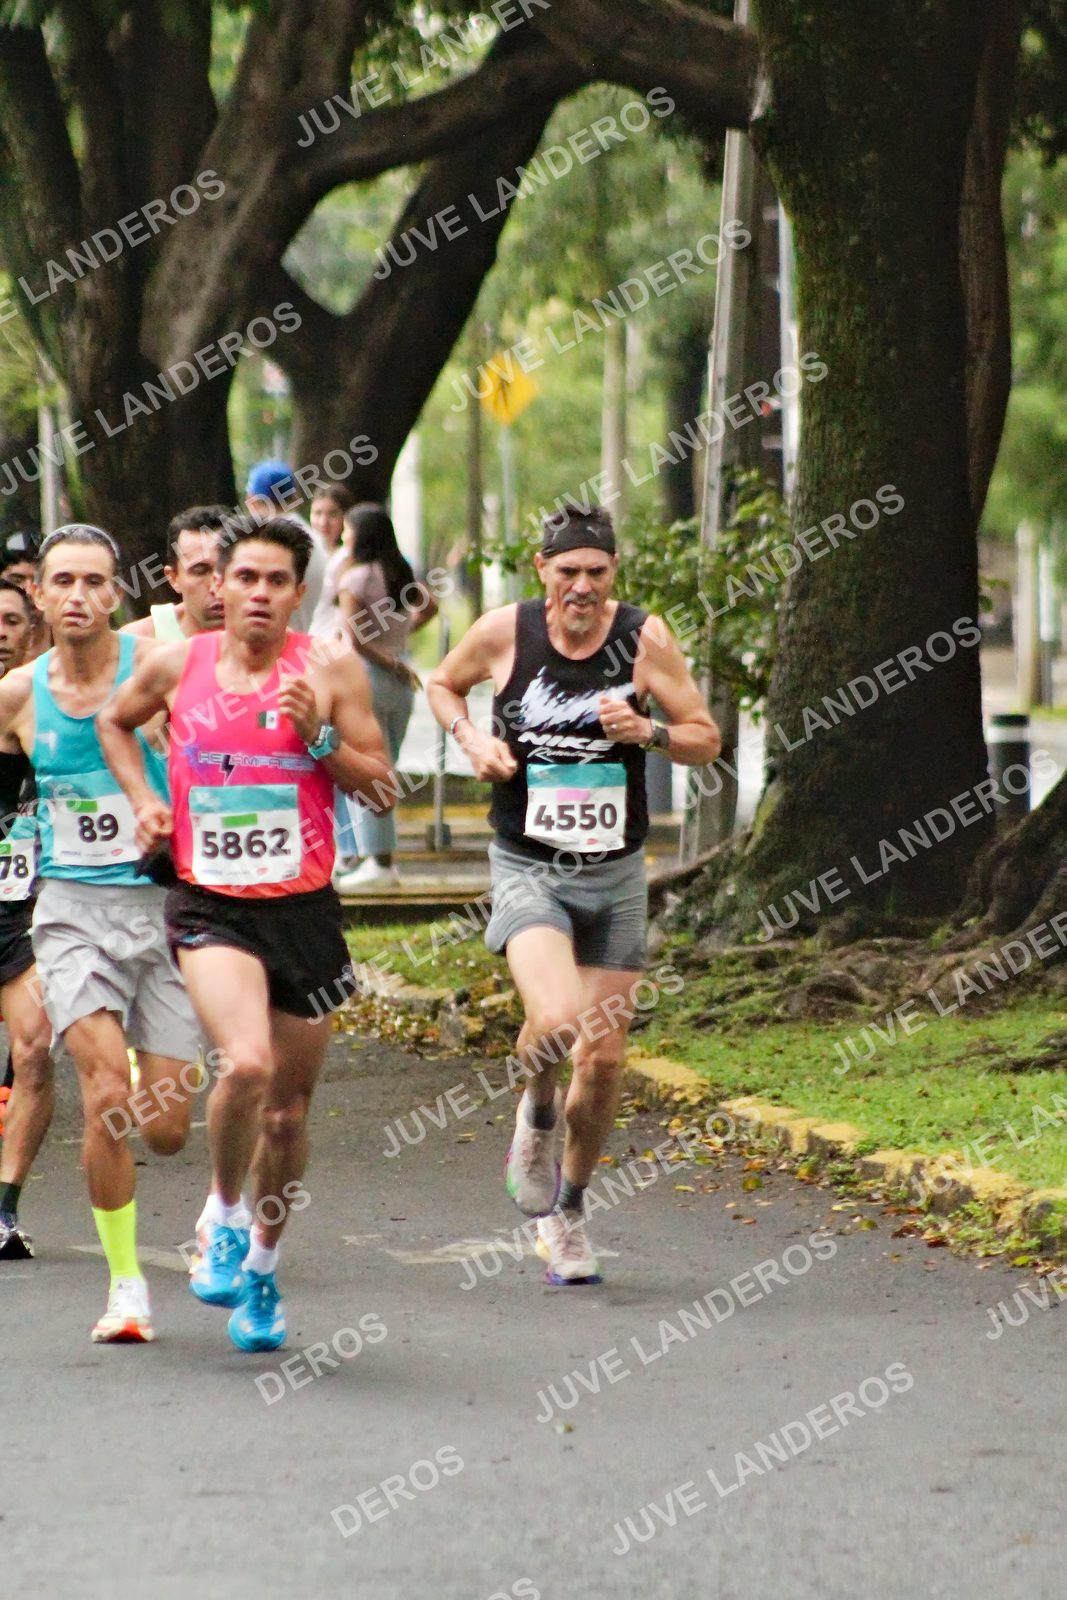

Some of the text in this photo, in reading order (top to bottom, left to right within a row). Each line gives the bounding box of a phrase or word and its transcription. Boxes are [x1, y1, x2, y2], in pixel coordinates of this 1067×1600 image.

[518, 732, 616, 751] NIKE
[78, 813, 119, 843] 89
[534, 803, 618, 831] 4550
[201, 827, 291, 860] 5862
[0, 854, 29, 879] 78
